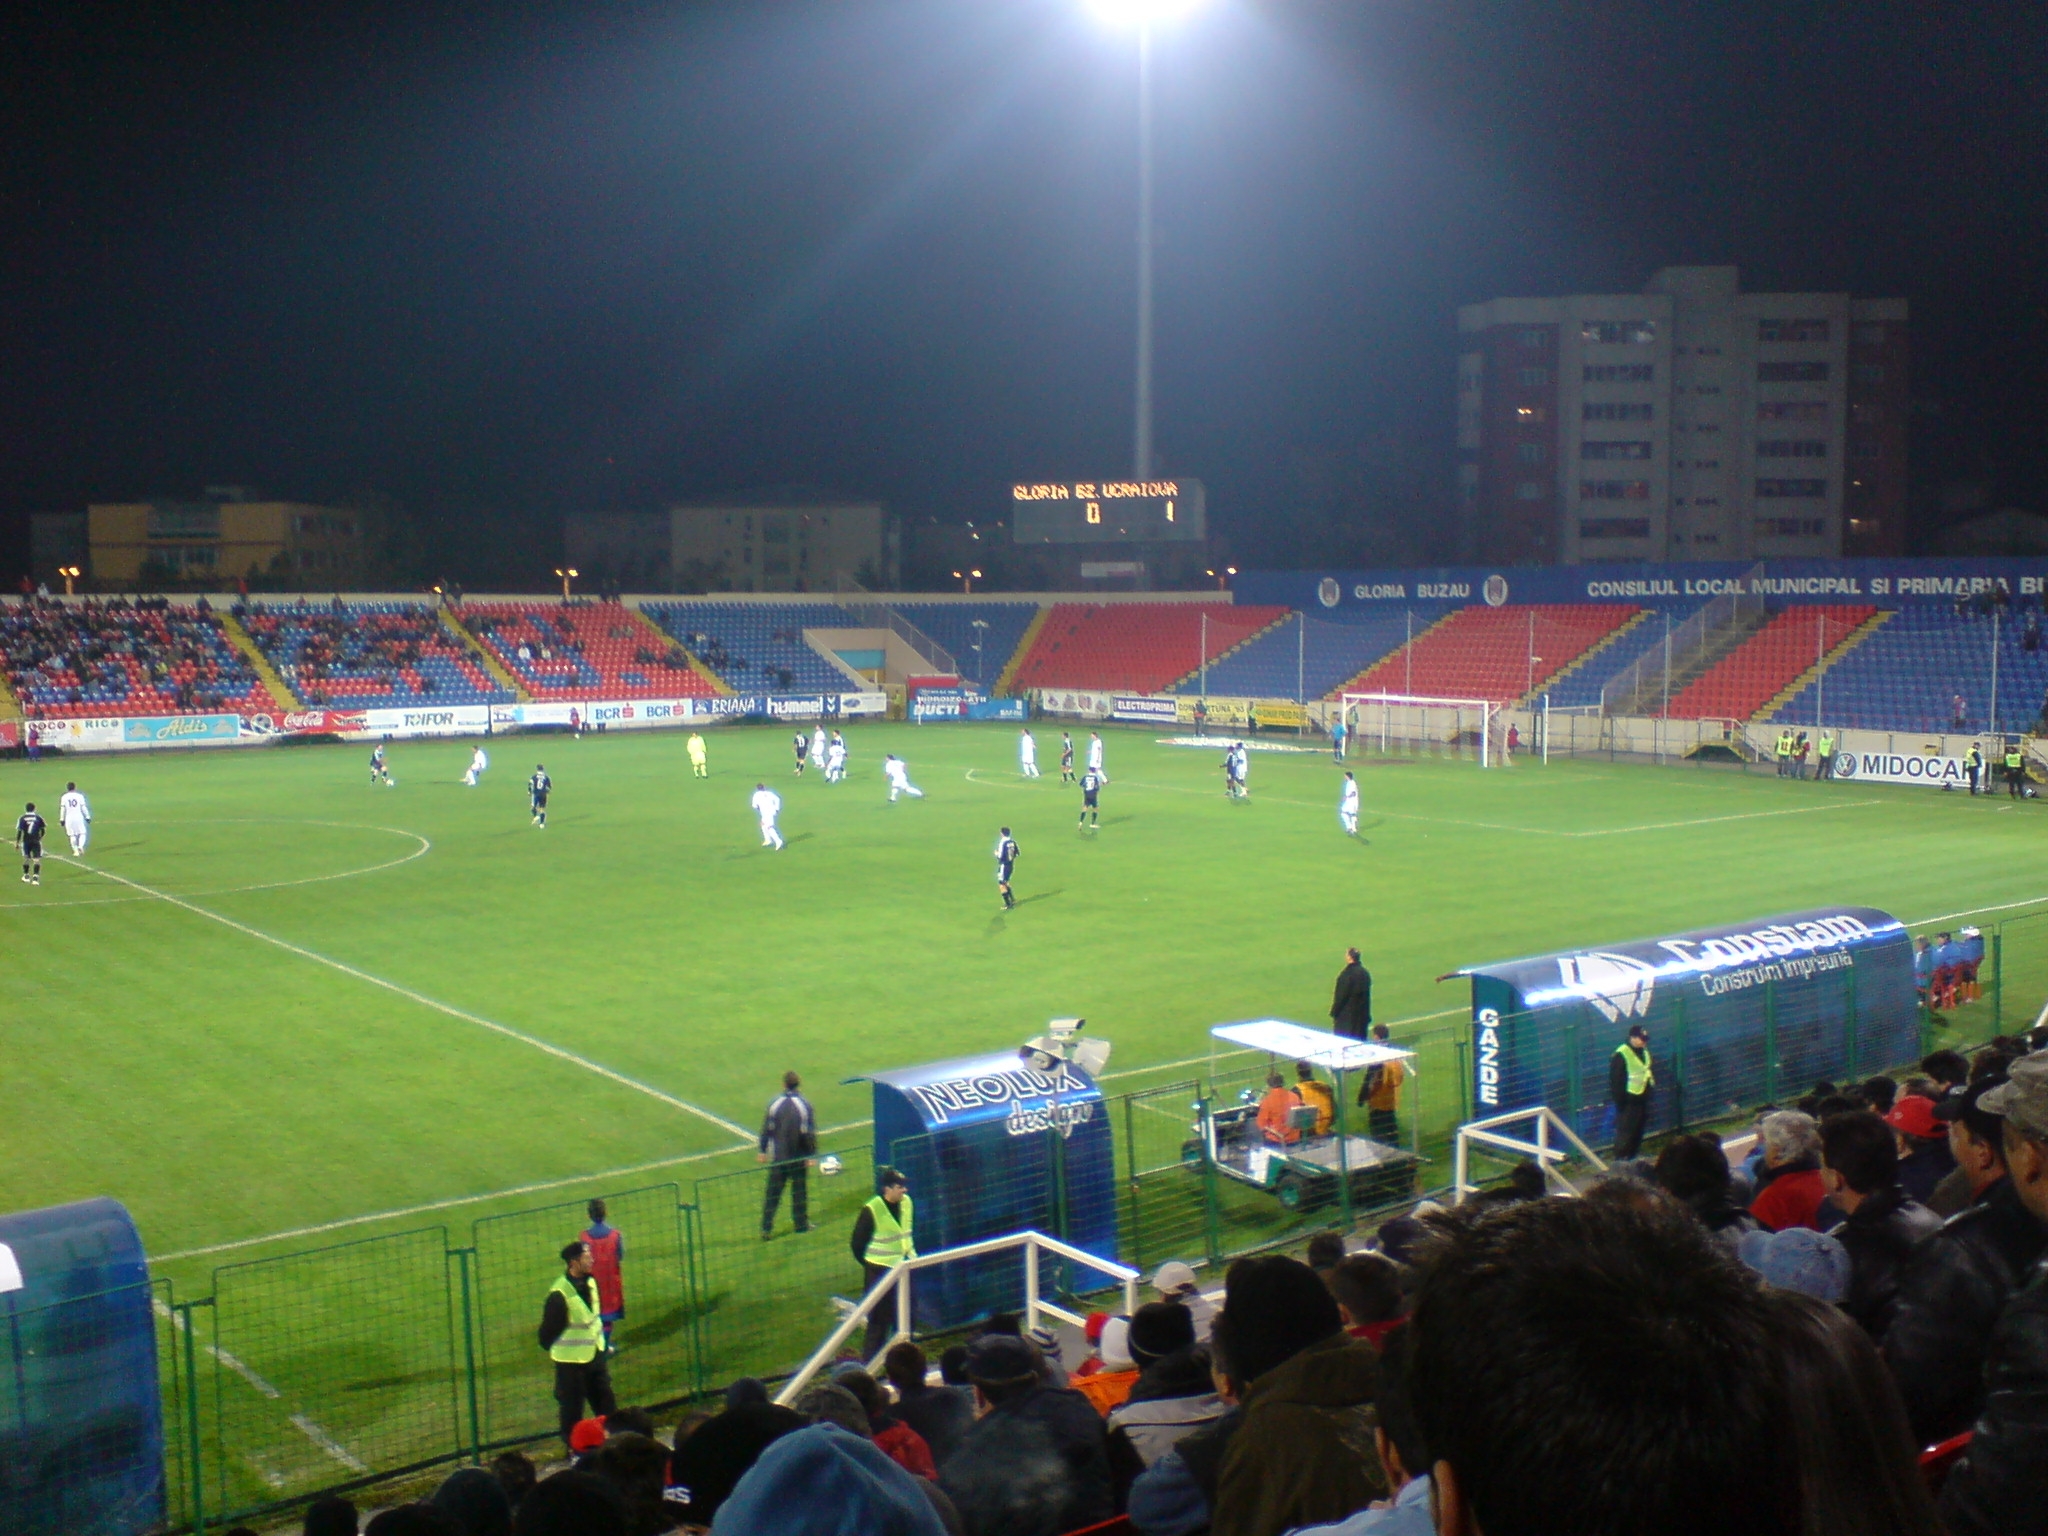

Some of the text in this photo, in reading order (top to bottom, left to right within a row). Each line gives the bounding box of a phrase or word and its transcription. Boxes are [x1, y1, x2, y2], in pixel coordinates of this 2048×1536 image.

[1014, 484, 1069, 500] GLORIA
[1086, 500, 1174, 524] 0 1
[1354, 583, 1470, 599] GLORIA BUZAU
[1587, 579, 1679, 597] CONSILIUL
[1684, 578, 1746, 595] LOCAL
[1751, 577, 1861, 594] MUNICIPAL
[1870, 577, 1890, 594] SI
[646, 705, 670, 717] BCR
[712, 697, 755, 713] BRIANA
[766, 696, 823, 714] hummel
[1117, 700, 1176, 712] ELECTROPRIMA
[595, 708, 621, 719] BCR
[68, 799, 78, 807] 10
[26, 821, 34, 834] 7
[1700, 963, 1781, 997] Construim
[1479, 1008, 1500, 1105] GAZDE
[912, 1063, 1086, 1124] NEOLUX
[1006, 1098, 1094, 1140] design
